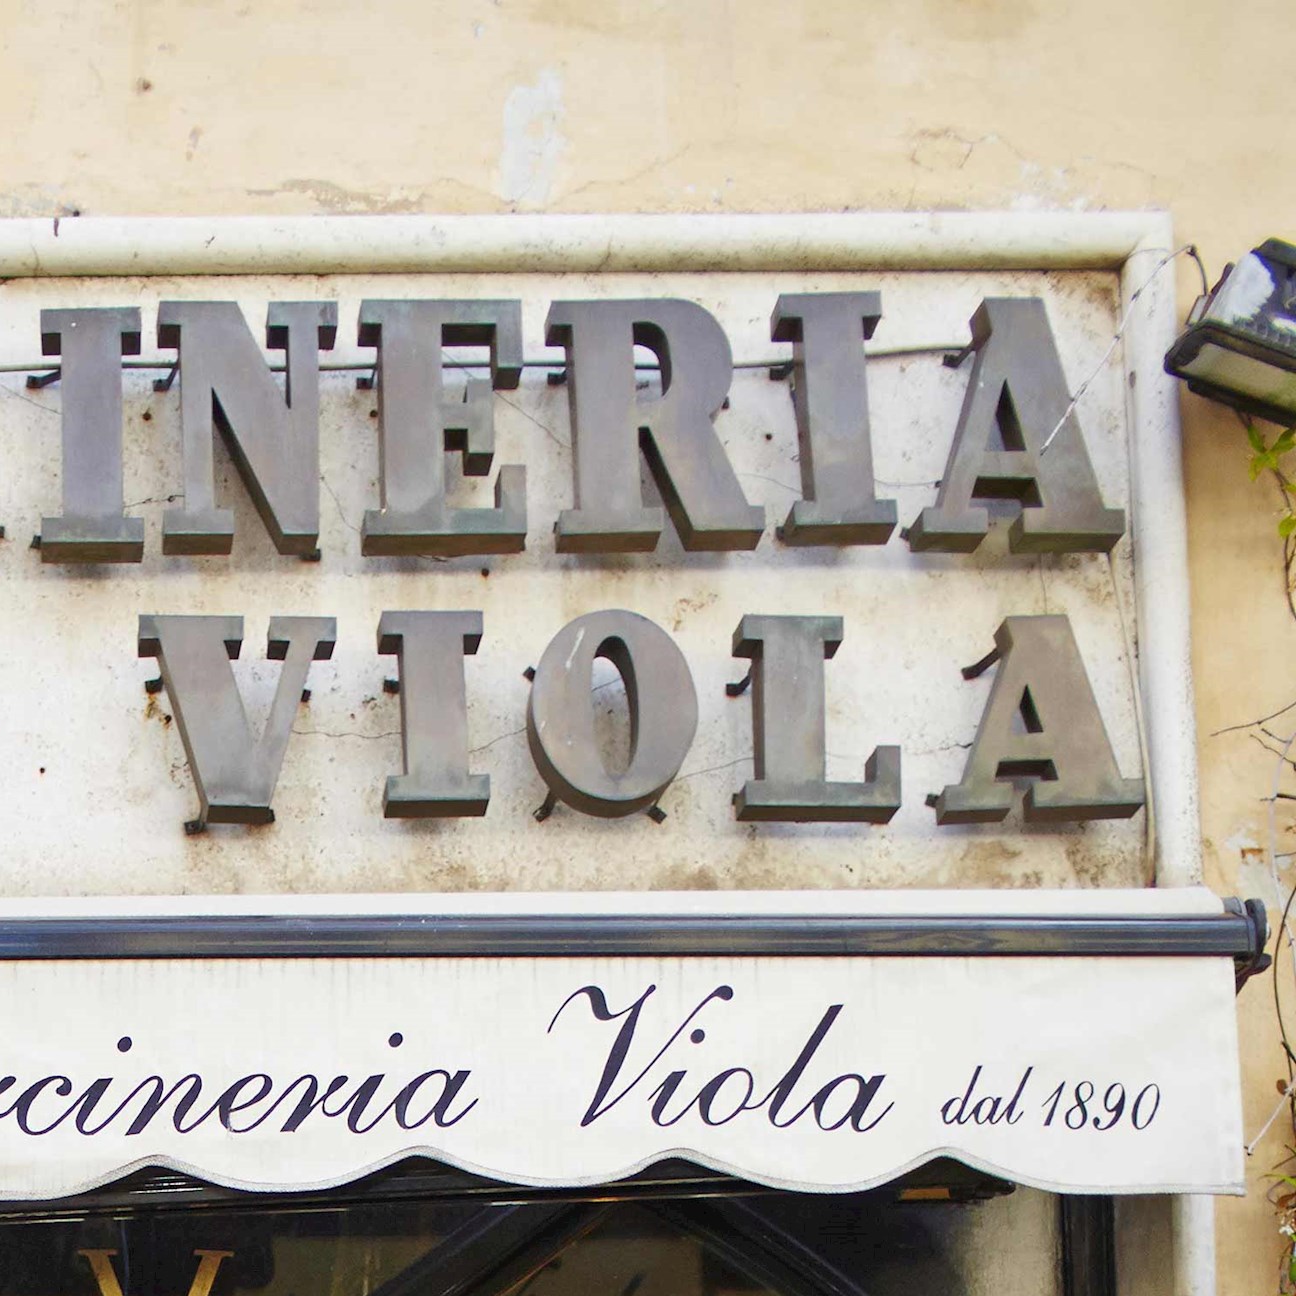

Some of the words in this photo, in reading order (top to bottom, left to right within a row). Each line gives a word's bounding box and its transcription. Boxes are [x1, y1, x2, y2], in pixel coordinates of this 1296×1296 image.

[137, 608, 1145, 826] VIOLA
[546, 984, 895, 1134] Viola
[940, 1066, 1031, 1128] dal
[1041, 1080, 1163, 1133] 1890
